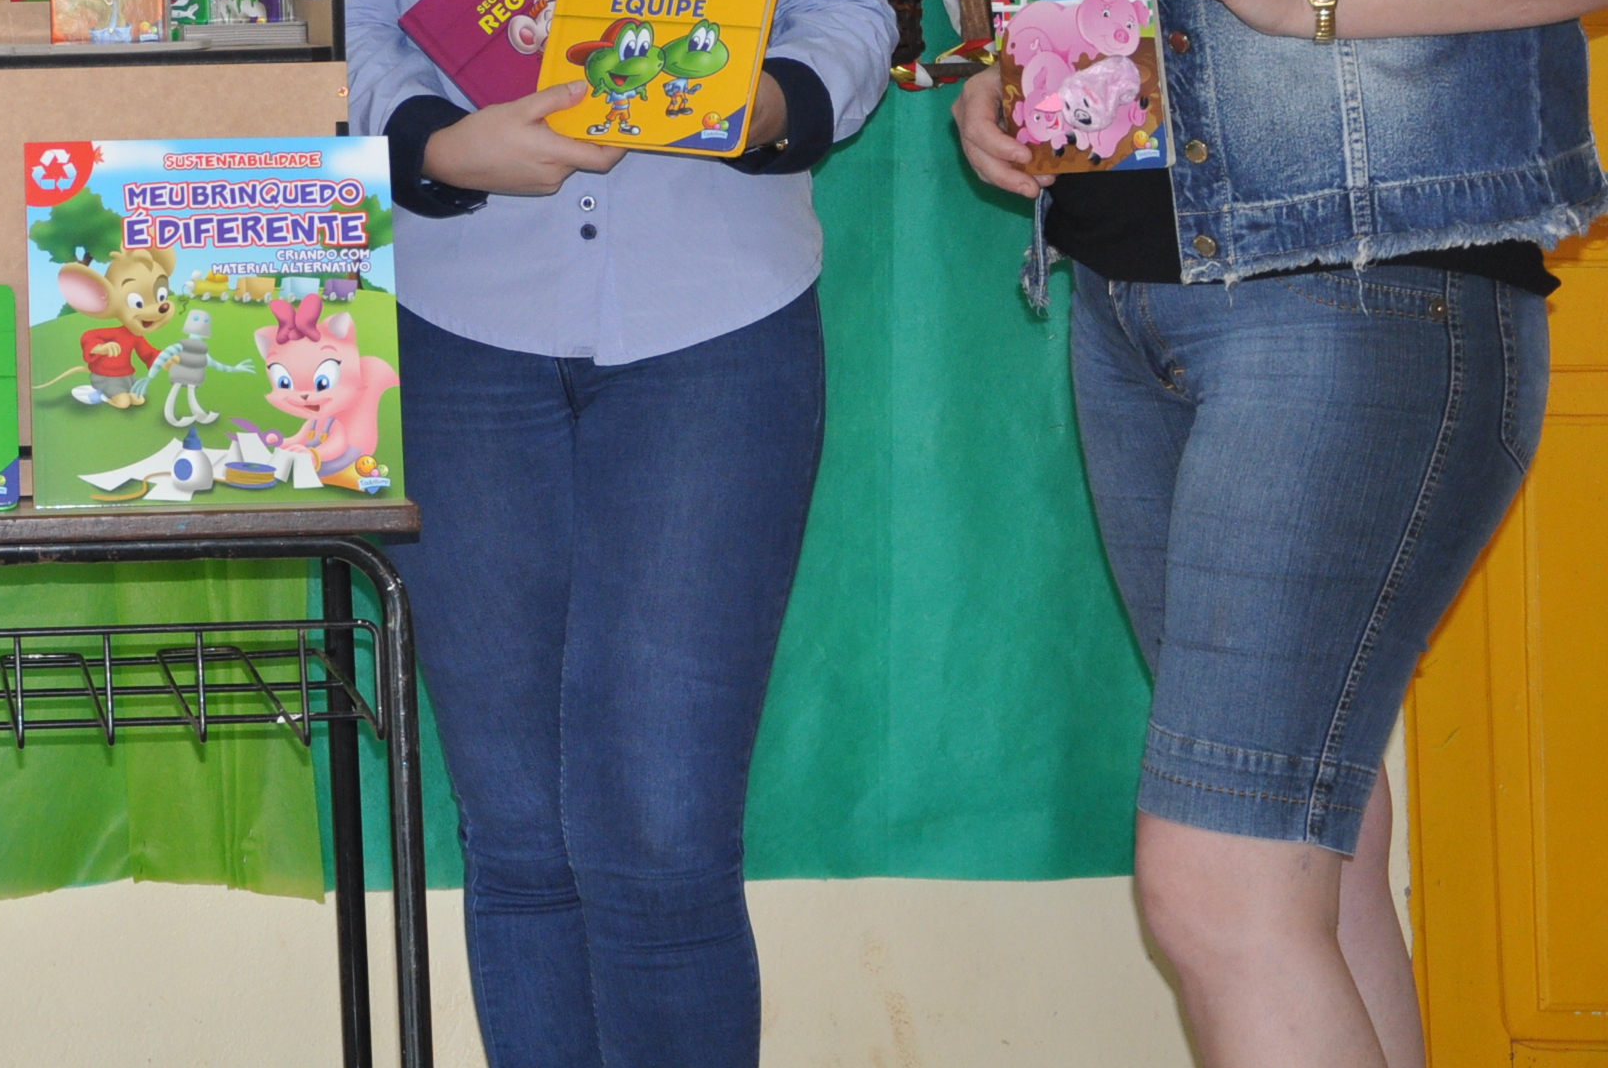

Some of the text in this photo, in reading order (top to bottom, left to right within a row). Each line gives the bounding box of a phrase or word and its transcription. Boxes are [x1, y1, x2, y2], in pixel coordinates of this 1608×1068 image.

[163, 151, 322, 170] SUSTENTABILIDADE
[125, 180, 363, 209] MEU BRINQUEDO
[124, 210, 366, 247] É DIFERENTE
[276, 249, 371, 262] CRIANDO COM
[212, 260, 372, 275] MATERIAL ALTERNATIVO
